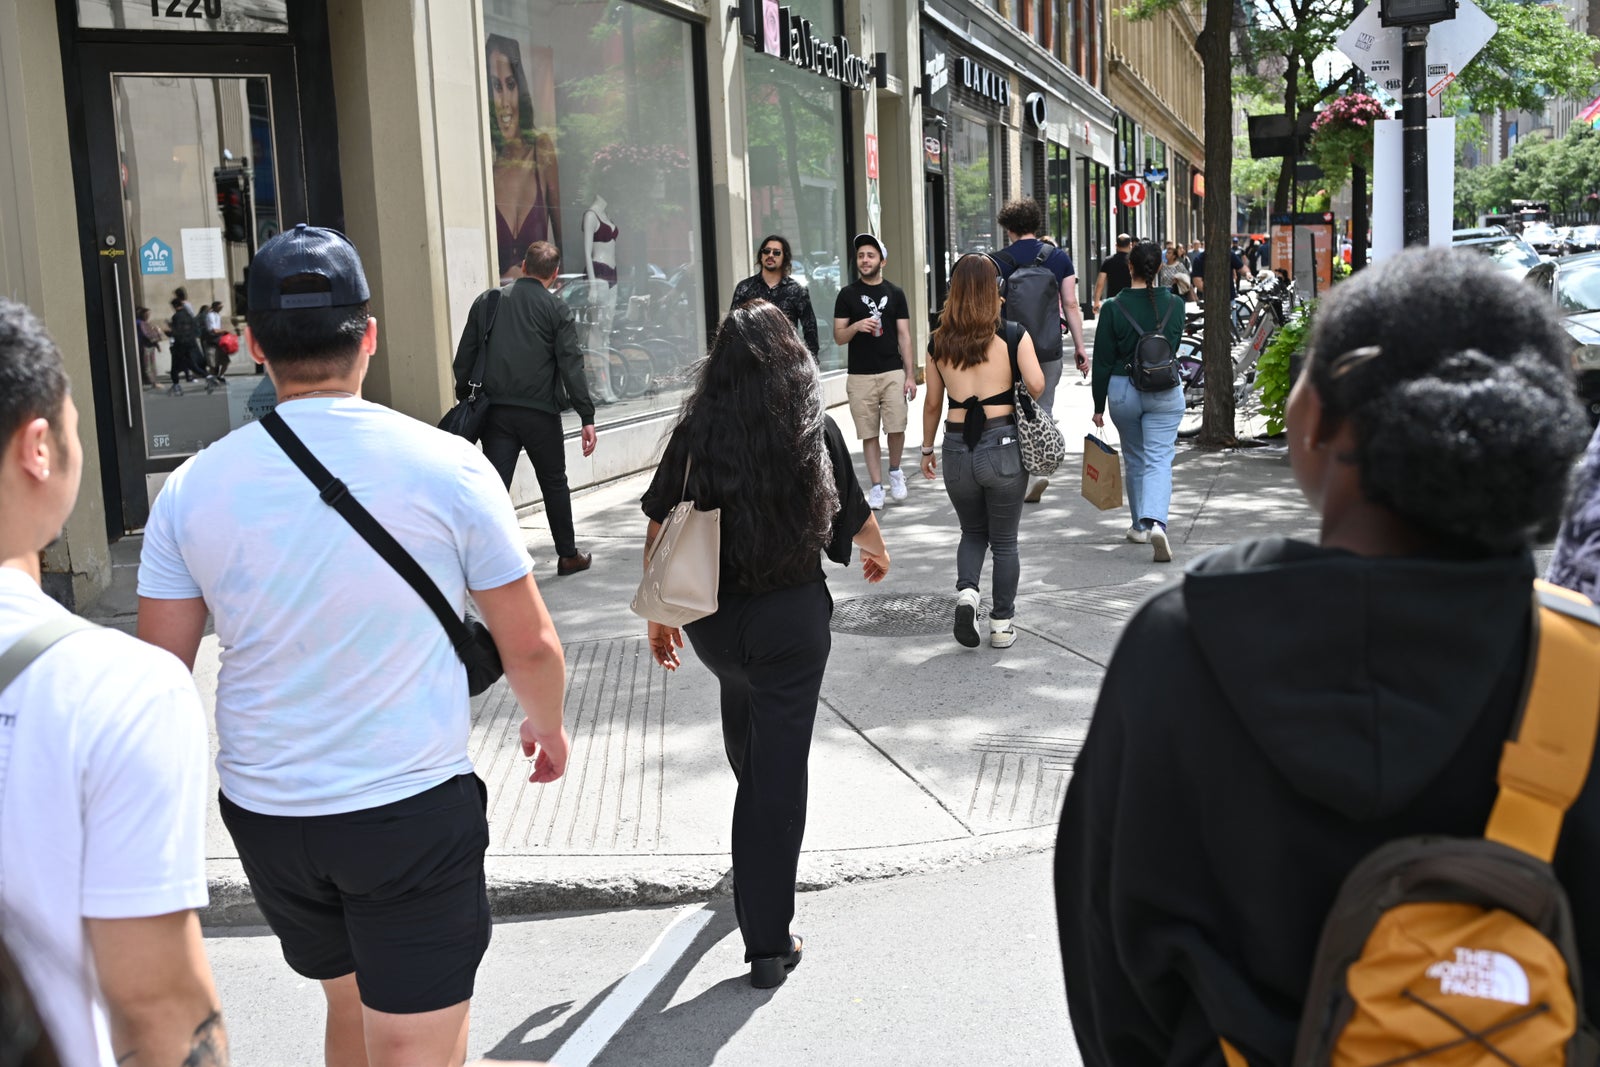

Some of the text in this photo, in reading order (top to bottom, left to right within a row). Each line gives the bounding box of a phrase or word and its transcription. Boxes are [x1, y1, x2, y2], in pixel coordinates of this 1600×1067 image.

[152, 0, 222, 19] 1220
[960, 56, 1011, 107] OAKLEY
[153, 437, 170, 448] SPC
[1453, 946, 1495, 966] THE
